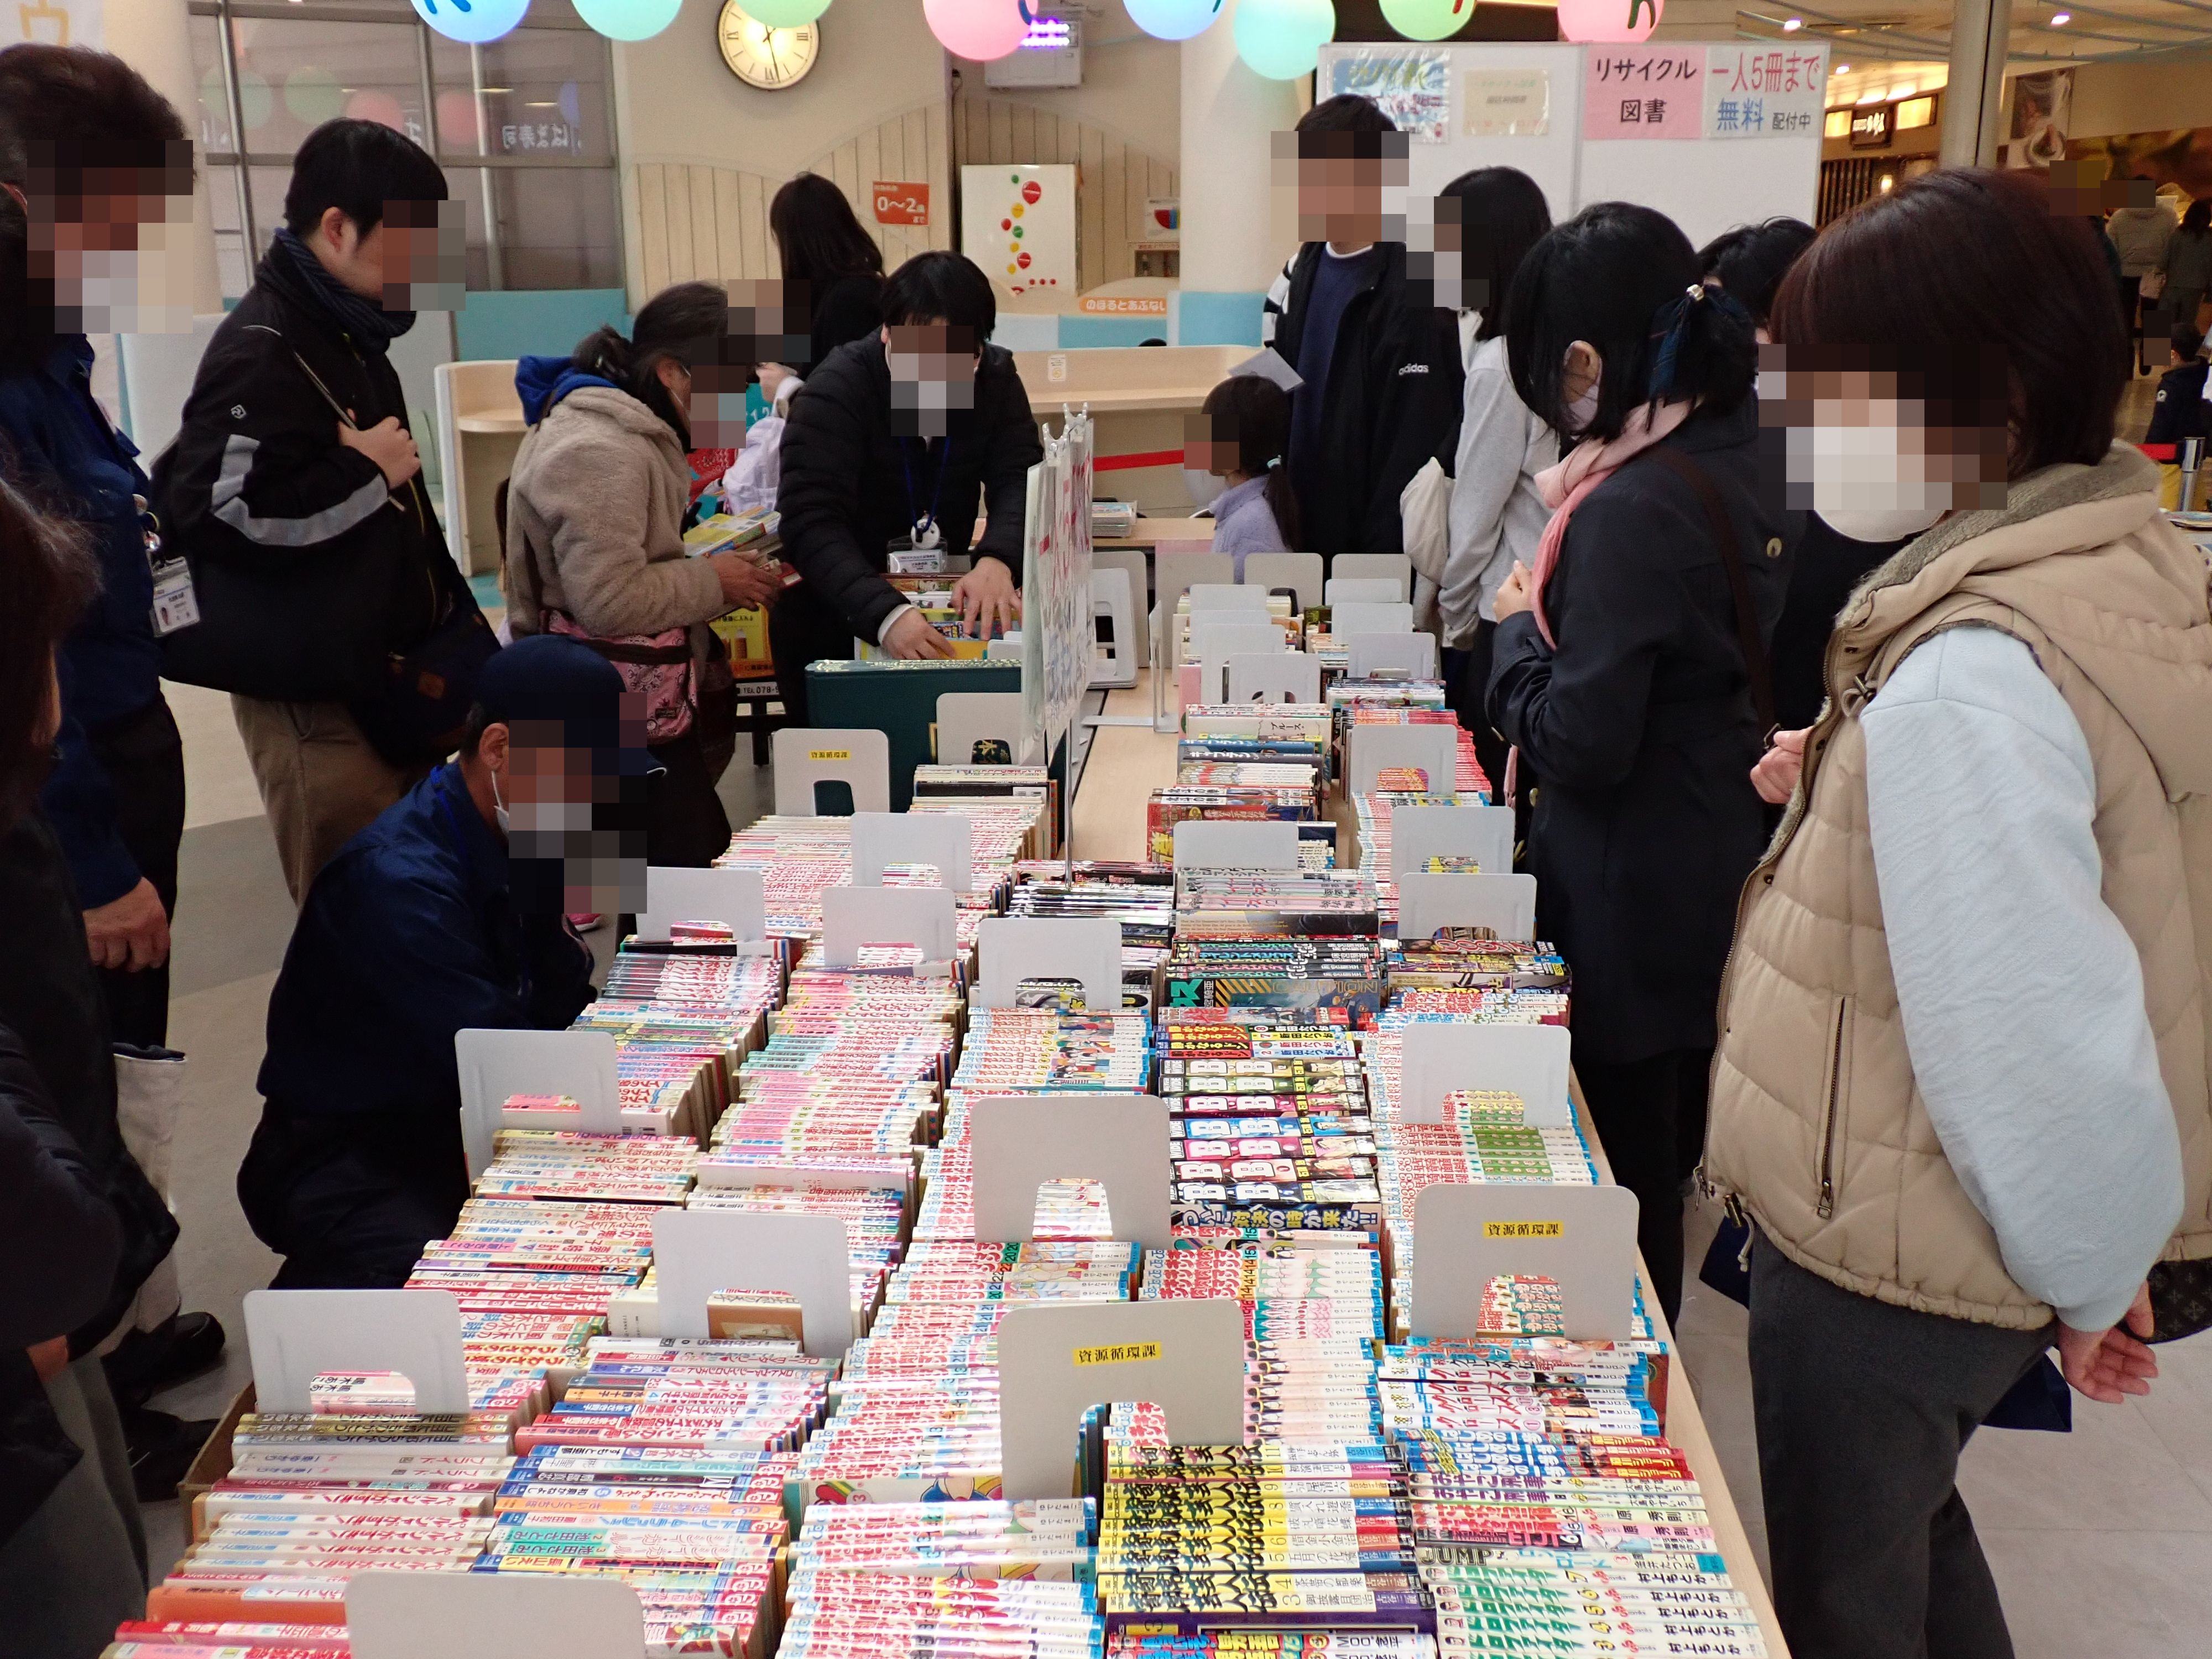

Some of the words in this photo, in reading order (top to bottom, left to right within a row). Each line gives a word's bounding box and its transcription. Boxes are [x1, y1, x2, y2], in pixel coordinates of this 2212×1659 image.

[1597, 58, 1697, 81] リサイクル
[1712, 52, 1819, 92] 一人5冊まで
[1620, 98, 1667, 123] 図書
[1718, 98, 1764, 131] 無料
[1772, 112, 1811, 131] 配付中
[1399, 363, 1429, 375] adidas
[1171, 1226, 1241, 1237] キン肉マン
[1488, 1224, 1558, 1236] 資源循環課
[1165, 1250, 1240, 1260] キン肉マン
[1159, 1288, 1238, 1298] キン肉マン
[1078, 1344, 1157, 1363] 資源循環課
[1430, 1369, 1511, 1381] クローズ
[1428, 1383, 1510, 1394] クローズ
[1432, 1394, 1514, 1405] クローズ
[1438, 1404, 1522, 1415] クローズ
[1437, 1416, 1521, 1429] クローズ
[1266, 1447, 1280, 1458] 11
[1267, 1464, 1284, 1475] 10
[1431, 1474, 1546, 1489] おやこ刑事
[1433, 1489, 1550, 1503] おやこ刑事
[1269, 1503, 1284, 1511] 8
[1616, 1509, 1632, 1520] 原
[1270, 1518, 1284, 1527] 7
[1623, 1525, 1639, 1535] 原
[1270, 1537, 1286, 1546] 6
[1270, 1553, 1285, 1562] 5
[1421, 1547, 1494, 1566] JUMP
[1564, 1569, 1588, 1583] 7
[1637, 1573, 1707, 1585] 村上もとか
[1275, 1578, 1292, 1589] 4
[1282, 1594, 1301, 1606] 3
[1577, 1588, 1600, 1600] 6
[1650, 1591, 1720, 1604] 村上もとか
[1582, 1605, 1606, 1616] 5
[1658, 1607, 1729, 1619] 村上もとか
[1589, 1621, 1612, 1634] 4
[1663, 1625, 1736, 1637] 村上もとか
[1593, 1640, 1615, 1651] 3
[1668, 1642, 1741, 1655] 村上もとか
